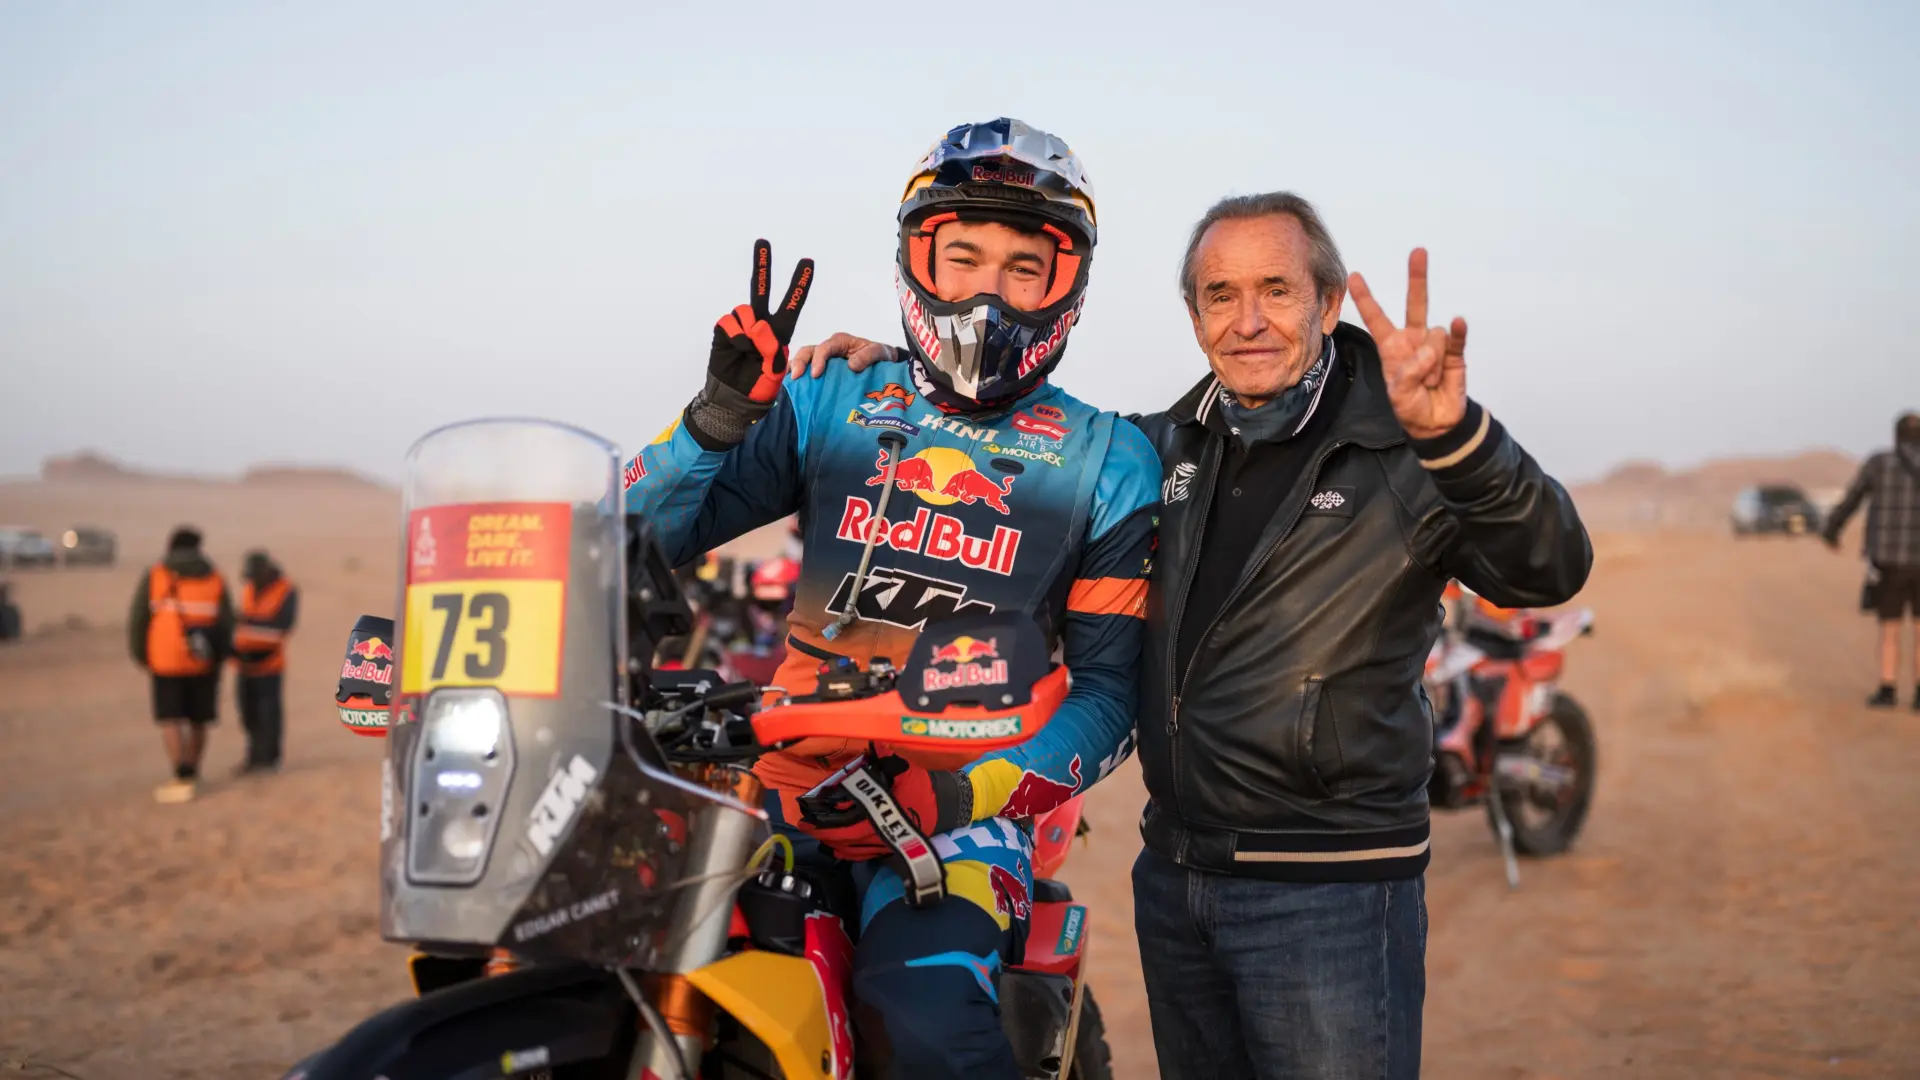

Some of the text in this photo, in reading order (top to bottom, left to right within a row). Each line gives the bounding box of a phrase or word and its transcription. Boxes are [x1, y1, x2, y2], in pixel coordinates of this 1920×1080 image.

[972, 165, 1036, 188] Red Bull
[758, 247, 767, 296] ONE VISION
[786, 267, 812, 310] ONE GOAL
[868, 418, 914, 431] MICHELIN
[917, 414, 1000, 443] KINI
[1001, 447, 1063, 467] MOTOREX
[836, 496, 1022, 576] Red Bull
[431, 592, 510, 681] 73
[341, 659, 392, 684] Red Bull
[923, 659, 1008, 692] Red Bull
[928, 716, 1019, 738] MOTOREX
[528, 754, 598, 857] KTM
[855, 778, 910, 839] OAKLEY
